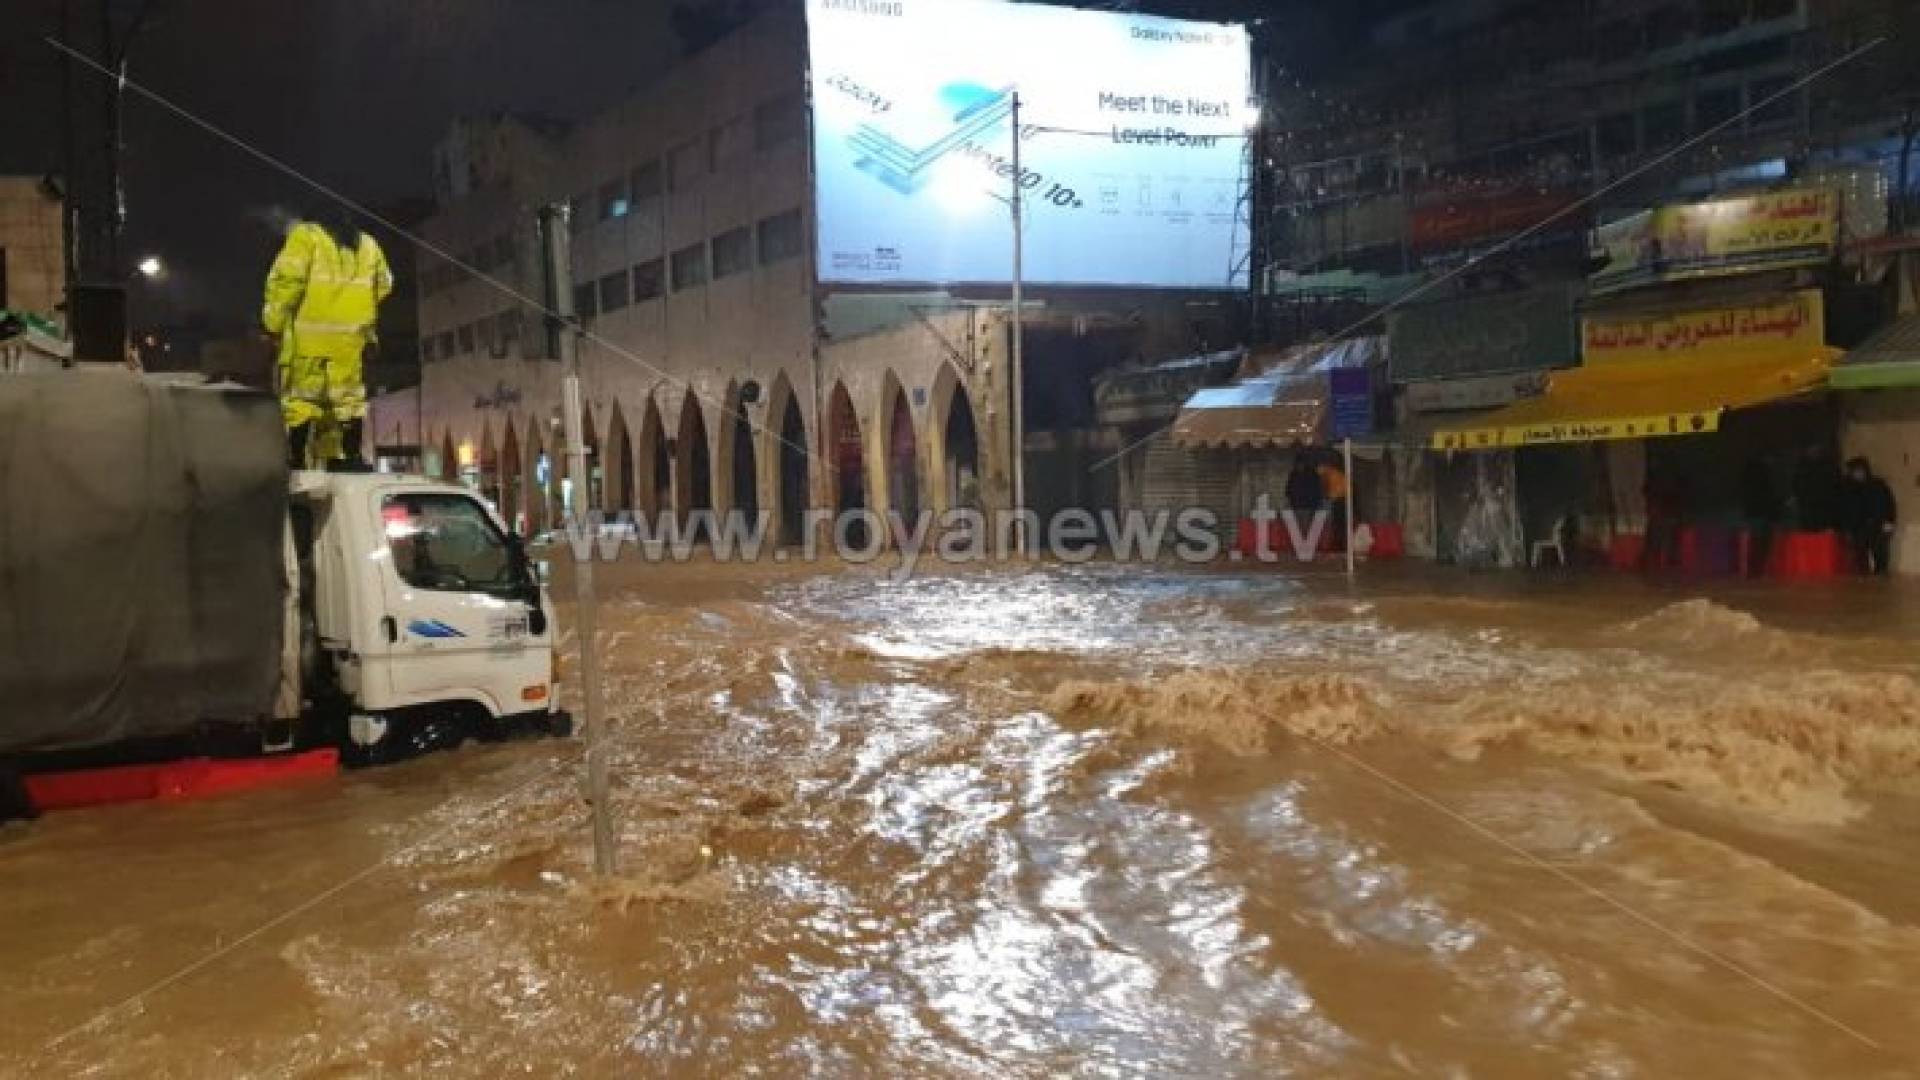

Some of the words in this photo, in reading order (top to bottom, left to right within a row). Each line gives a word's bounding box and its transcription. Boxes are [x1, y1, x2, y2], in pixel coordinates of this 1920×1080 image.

[1099, 91, 1146, 112] Meet
[1152, 94, 1184, 115] the
[1187, 97, 1230, 118] Next
[1112, 123, 1162, 145] Level
[1164, 126, 1217, 149] Power
